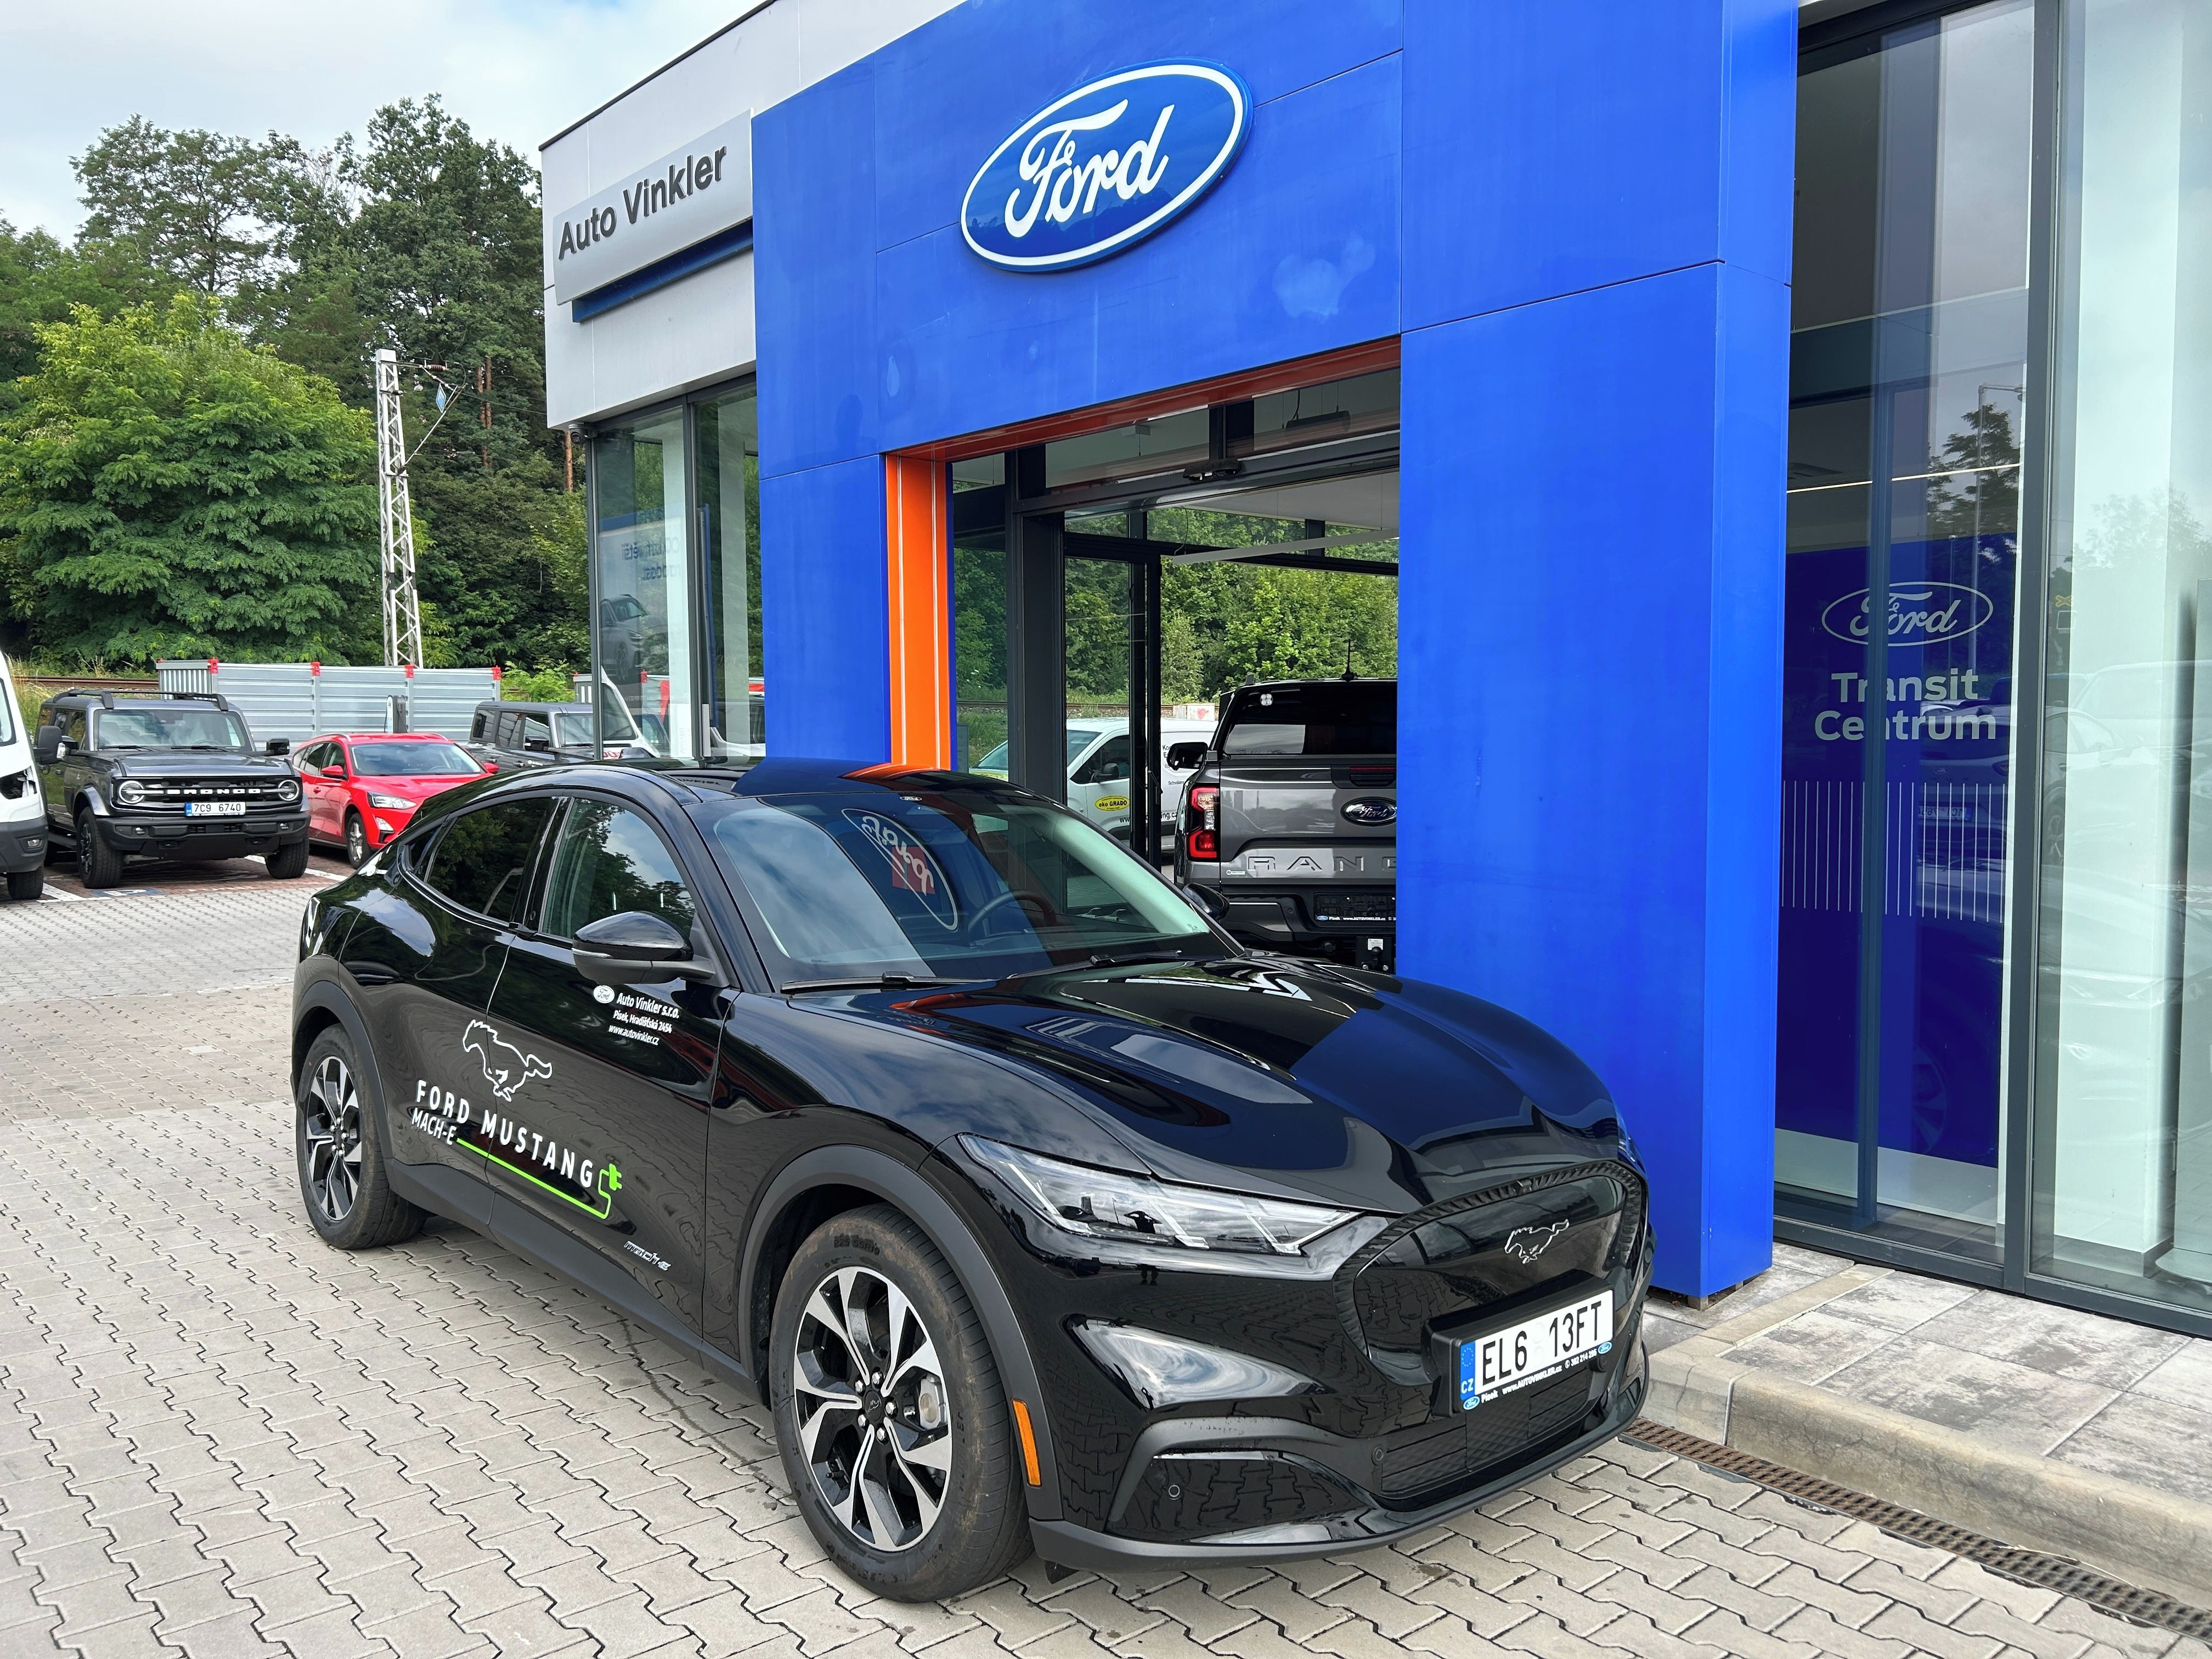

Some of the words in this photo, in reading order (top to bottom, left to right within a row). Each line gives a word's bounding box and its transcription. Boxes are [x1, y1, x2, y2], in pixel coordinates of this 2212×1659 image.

[1005, 98, 1175, 238] Ford
[558, 206, 617, 260] Auto
[623, 145, 727, 224] Vinkler
[1849, 591, 1961, 636] Ford
[1814, 710, 1996, 741] Cetrum
[194, 804, 211, 812] 7C9
[219, 803, 241, 812] 6740
[616, 992, 635, 1007] Auto
[635, 996, 663, 1014] Vinkler
[661, 1005, 680, 1019] s.r.o.
[608, 1025, 660, 1046] www.autovinkler.cz
[658, 1021, 673, 1034] 2454
[410, 1107, 458, 1146] MACH-E
[415, 1079, 470, 1124] FORD
[481, 1108, 593, 1188] MUSTANG
[1482, 1330, 1527, 1387] EL6
[1549, 1300, 1602, 1357] 13FT
[1461, 1378, 1474, 1394] CZ
